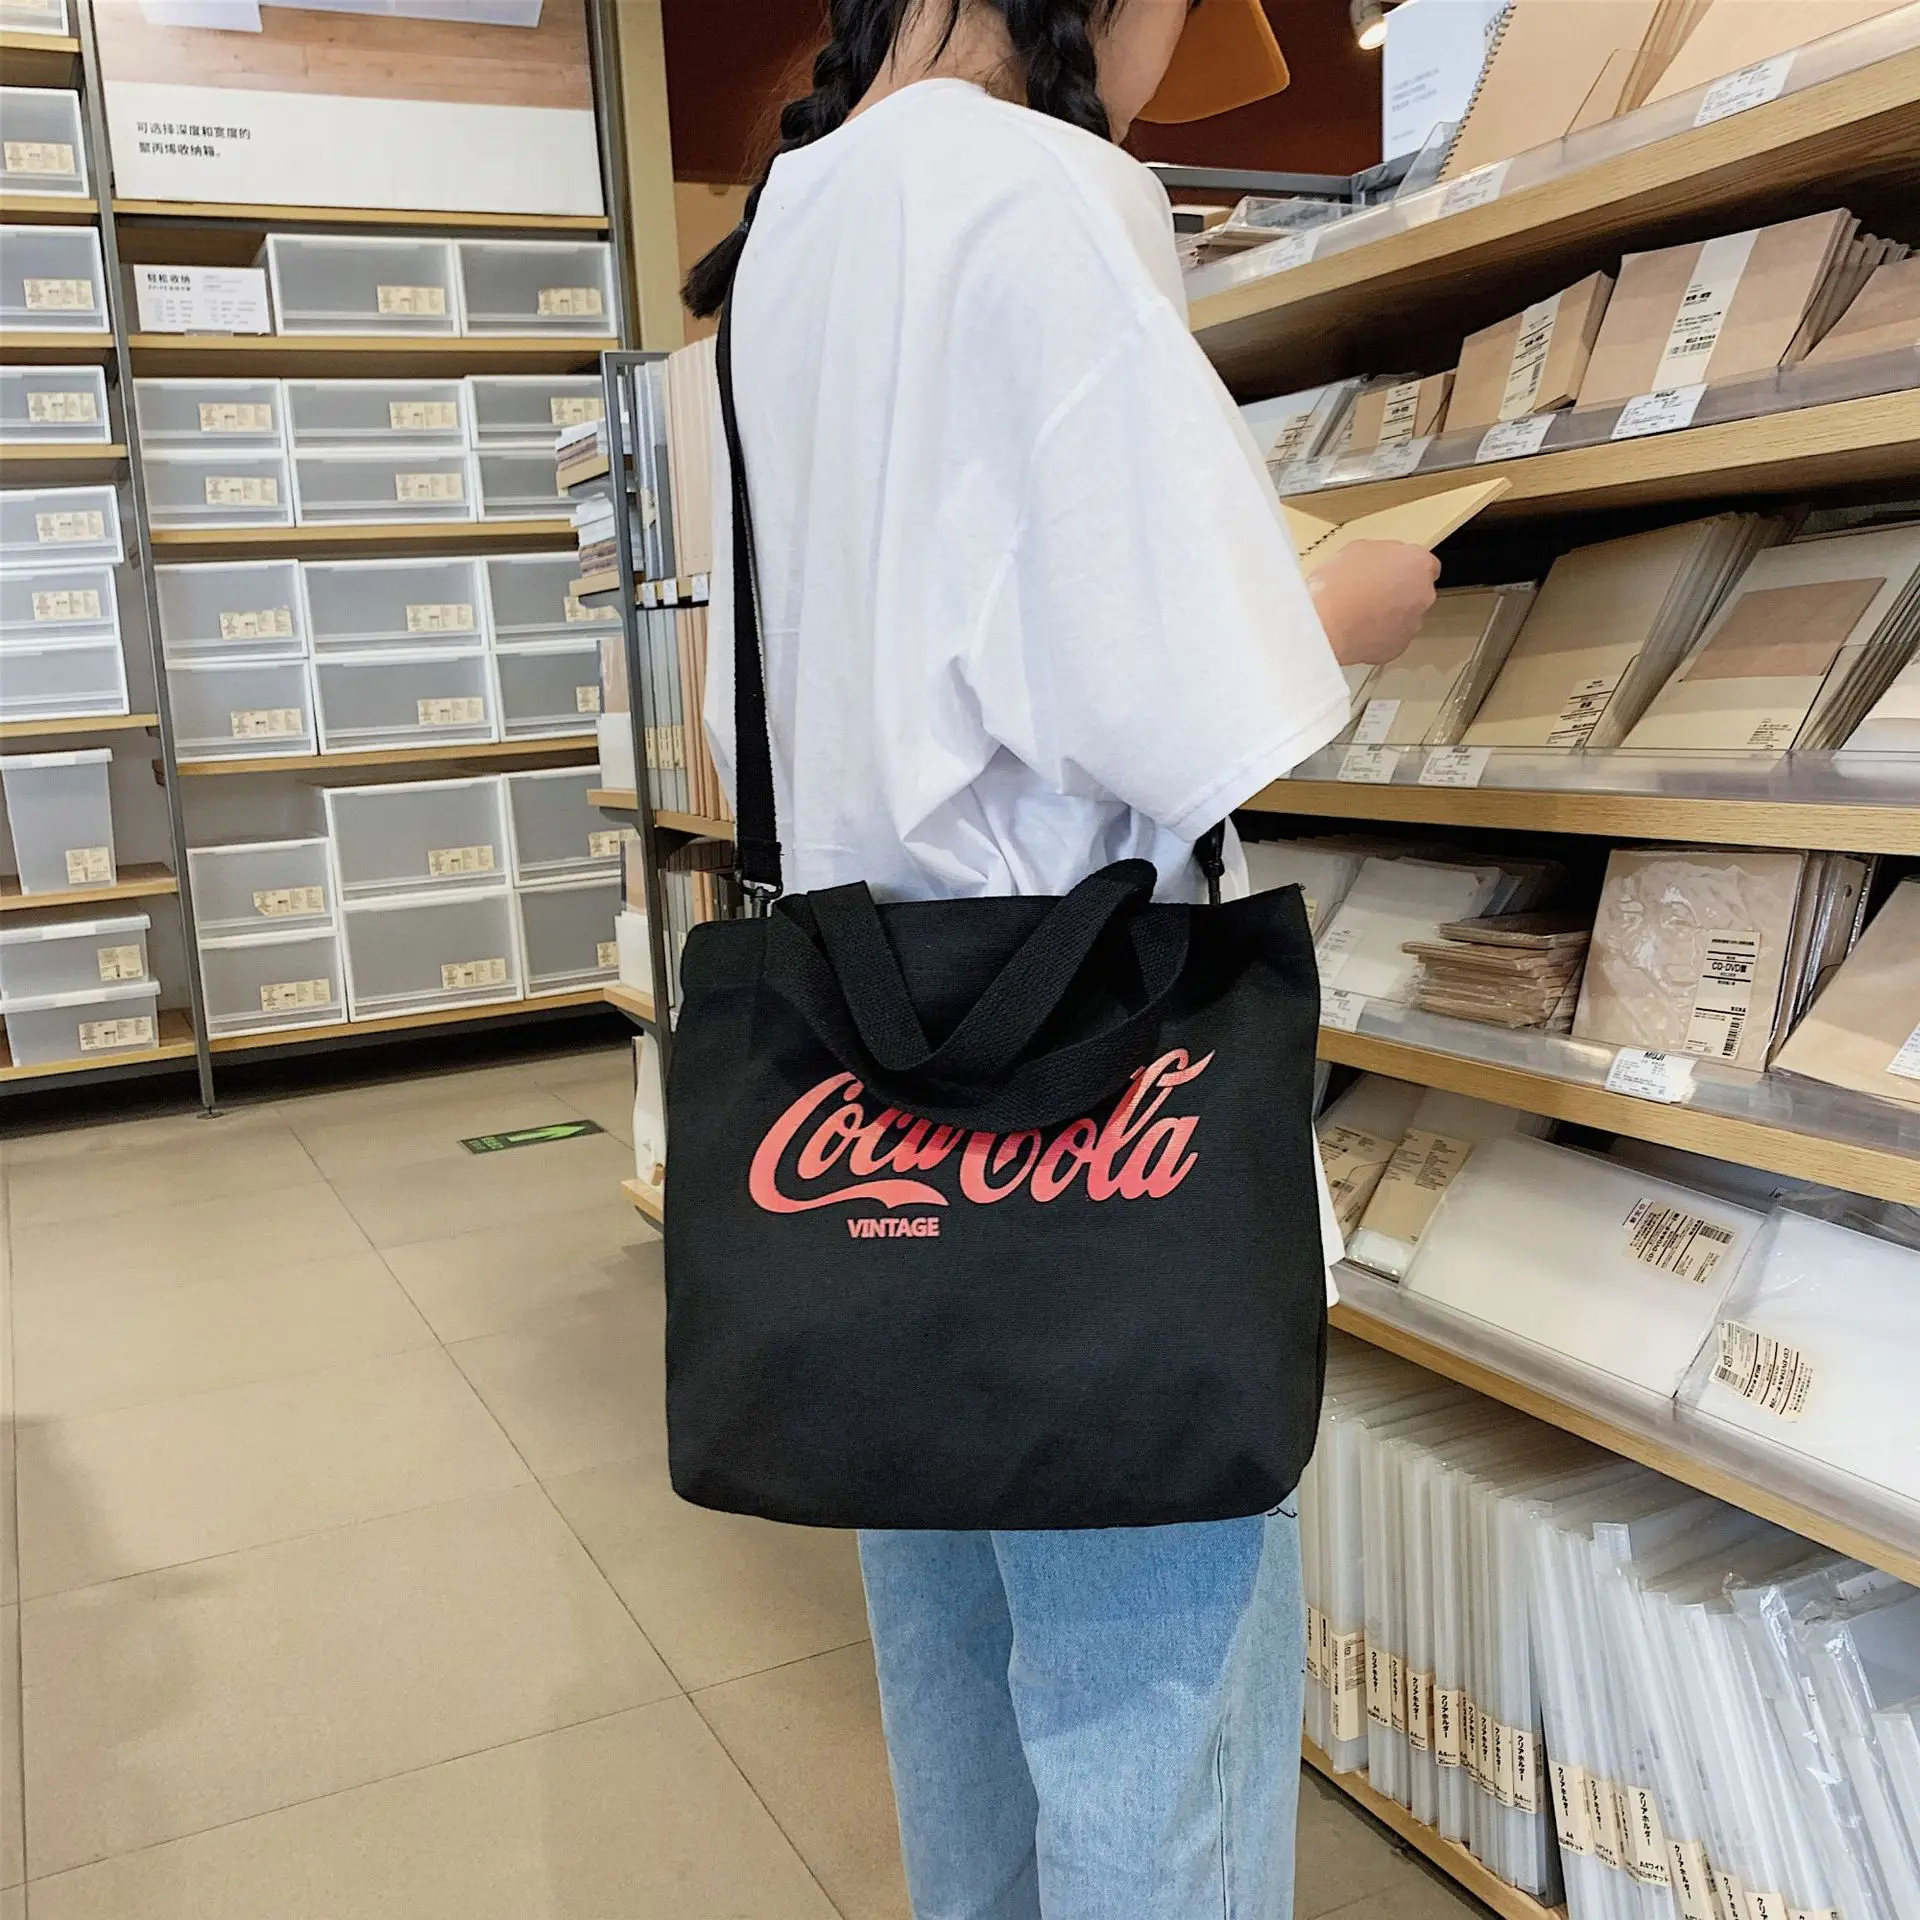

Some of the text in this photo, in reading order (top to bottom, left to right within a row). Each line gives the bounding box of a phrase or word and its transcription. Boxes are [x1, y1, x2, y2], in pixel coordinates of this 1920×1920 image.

[1643, 1051, 1666, 1062] MUJI
[847, 1216, 941, 1239] VINTAGE
[1440, 1694, 1450, 1739] クリアホルダー
[1517, 1735, 1526, 1782] クリアホルダー
[1558, 1766, 1569, 1817] クリアホルダー
[1639, 1791, 1651, 1847] クリアホルダー
[1674, 1844, 1692, 1900] クリアホルダー
